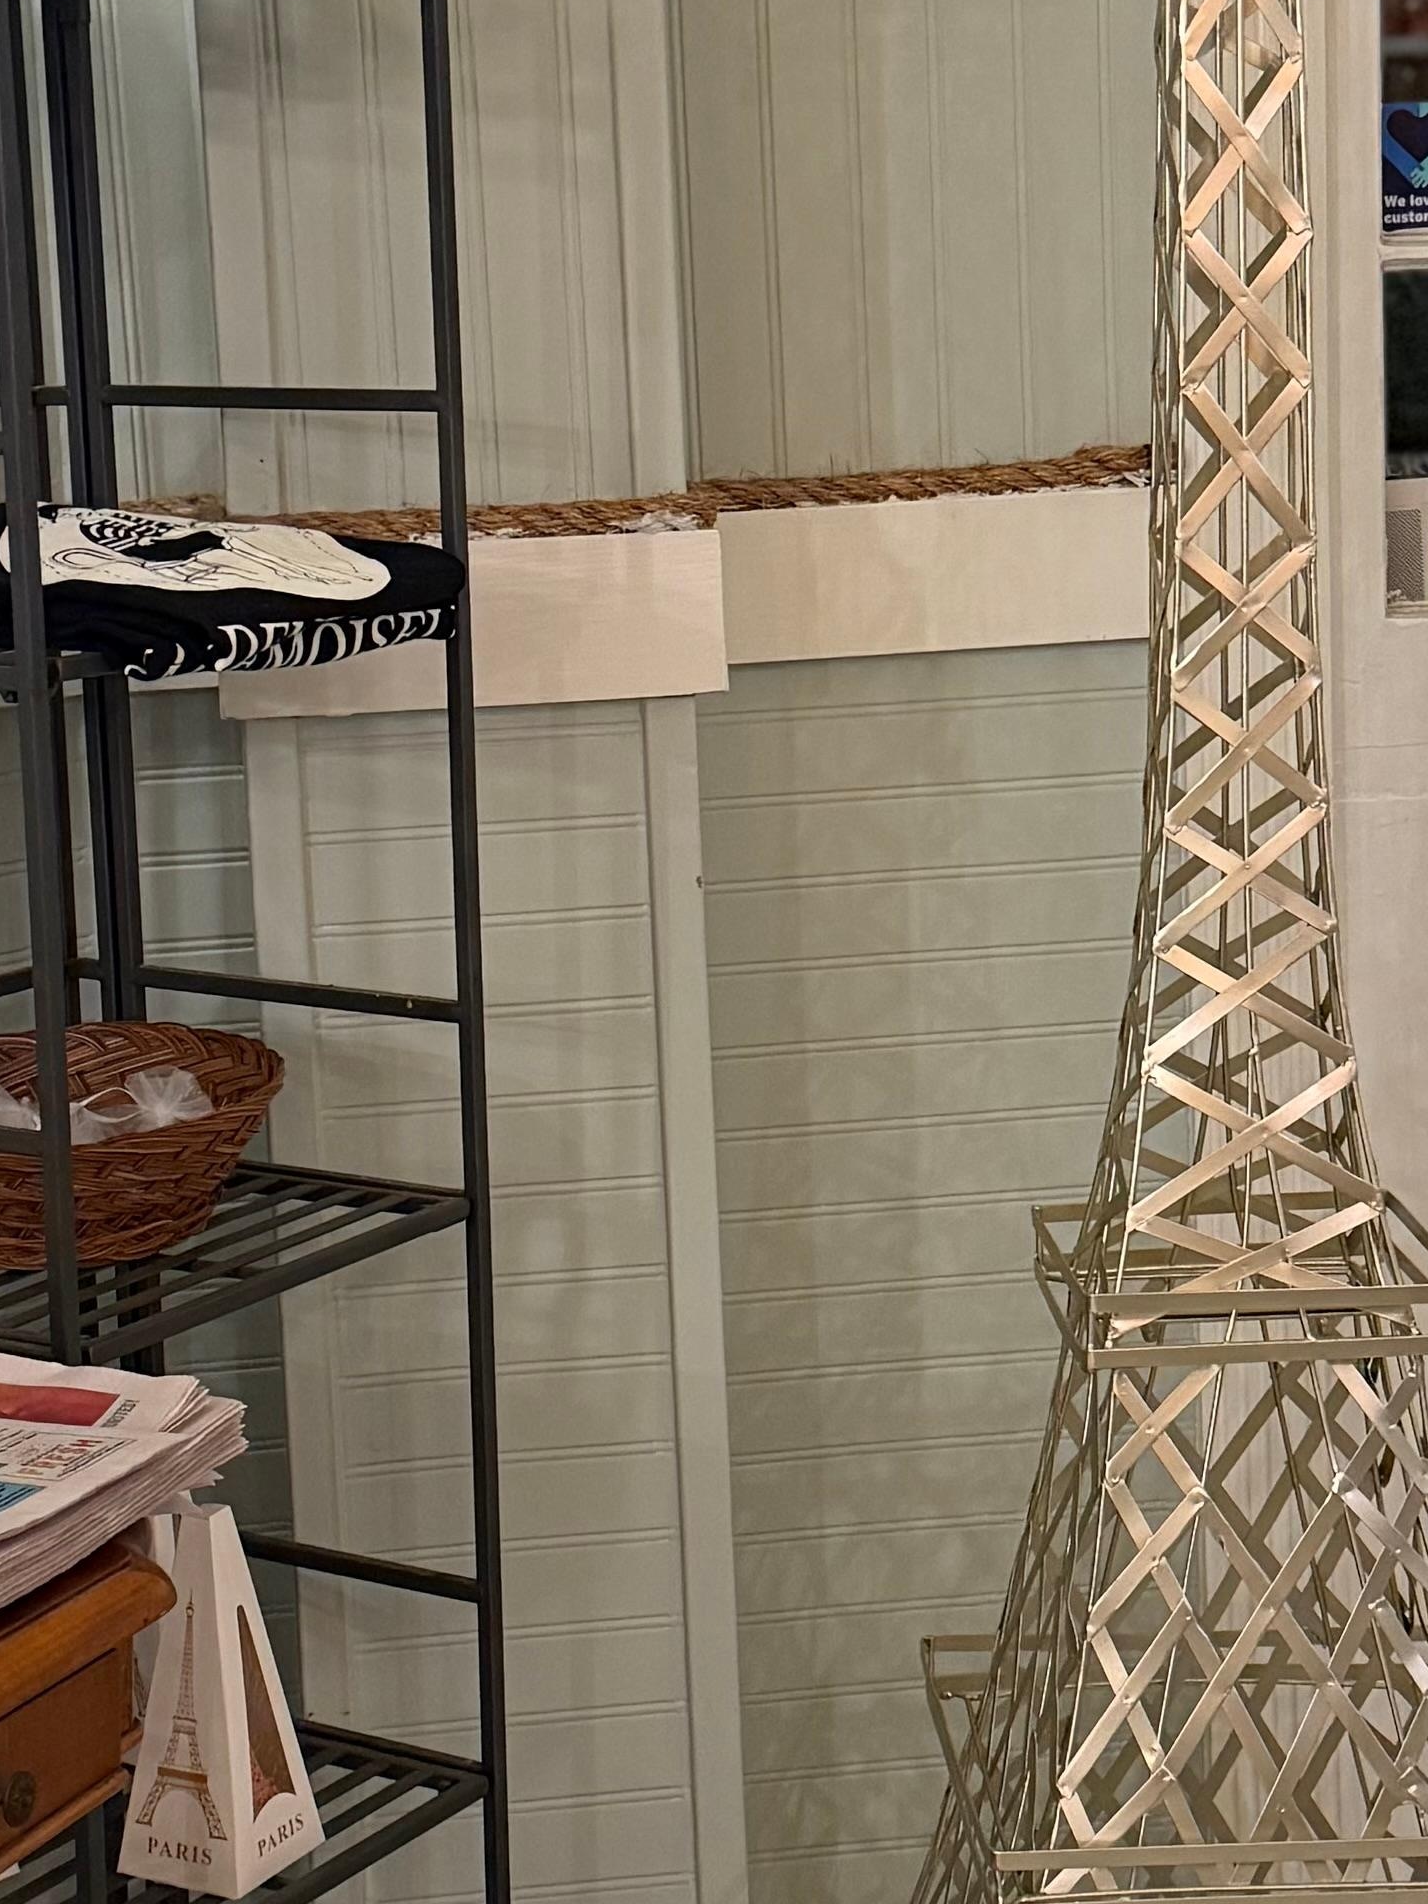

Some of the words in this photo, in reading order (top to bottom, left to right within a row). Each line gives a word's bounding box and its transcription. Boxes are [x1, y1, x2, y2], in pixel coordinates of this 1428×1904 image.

[1384, 194, 1406, 208] We
[258, 1812, 305, 1858] PARIS
[147, 1836, 213, 1866] PARIS
